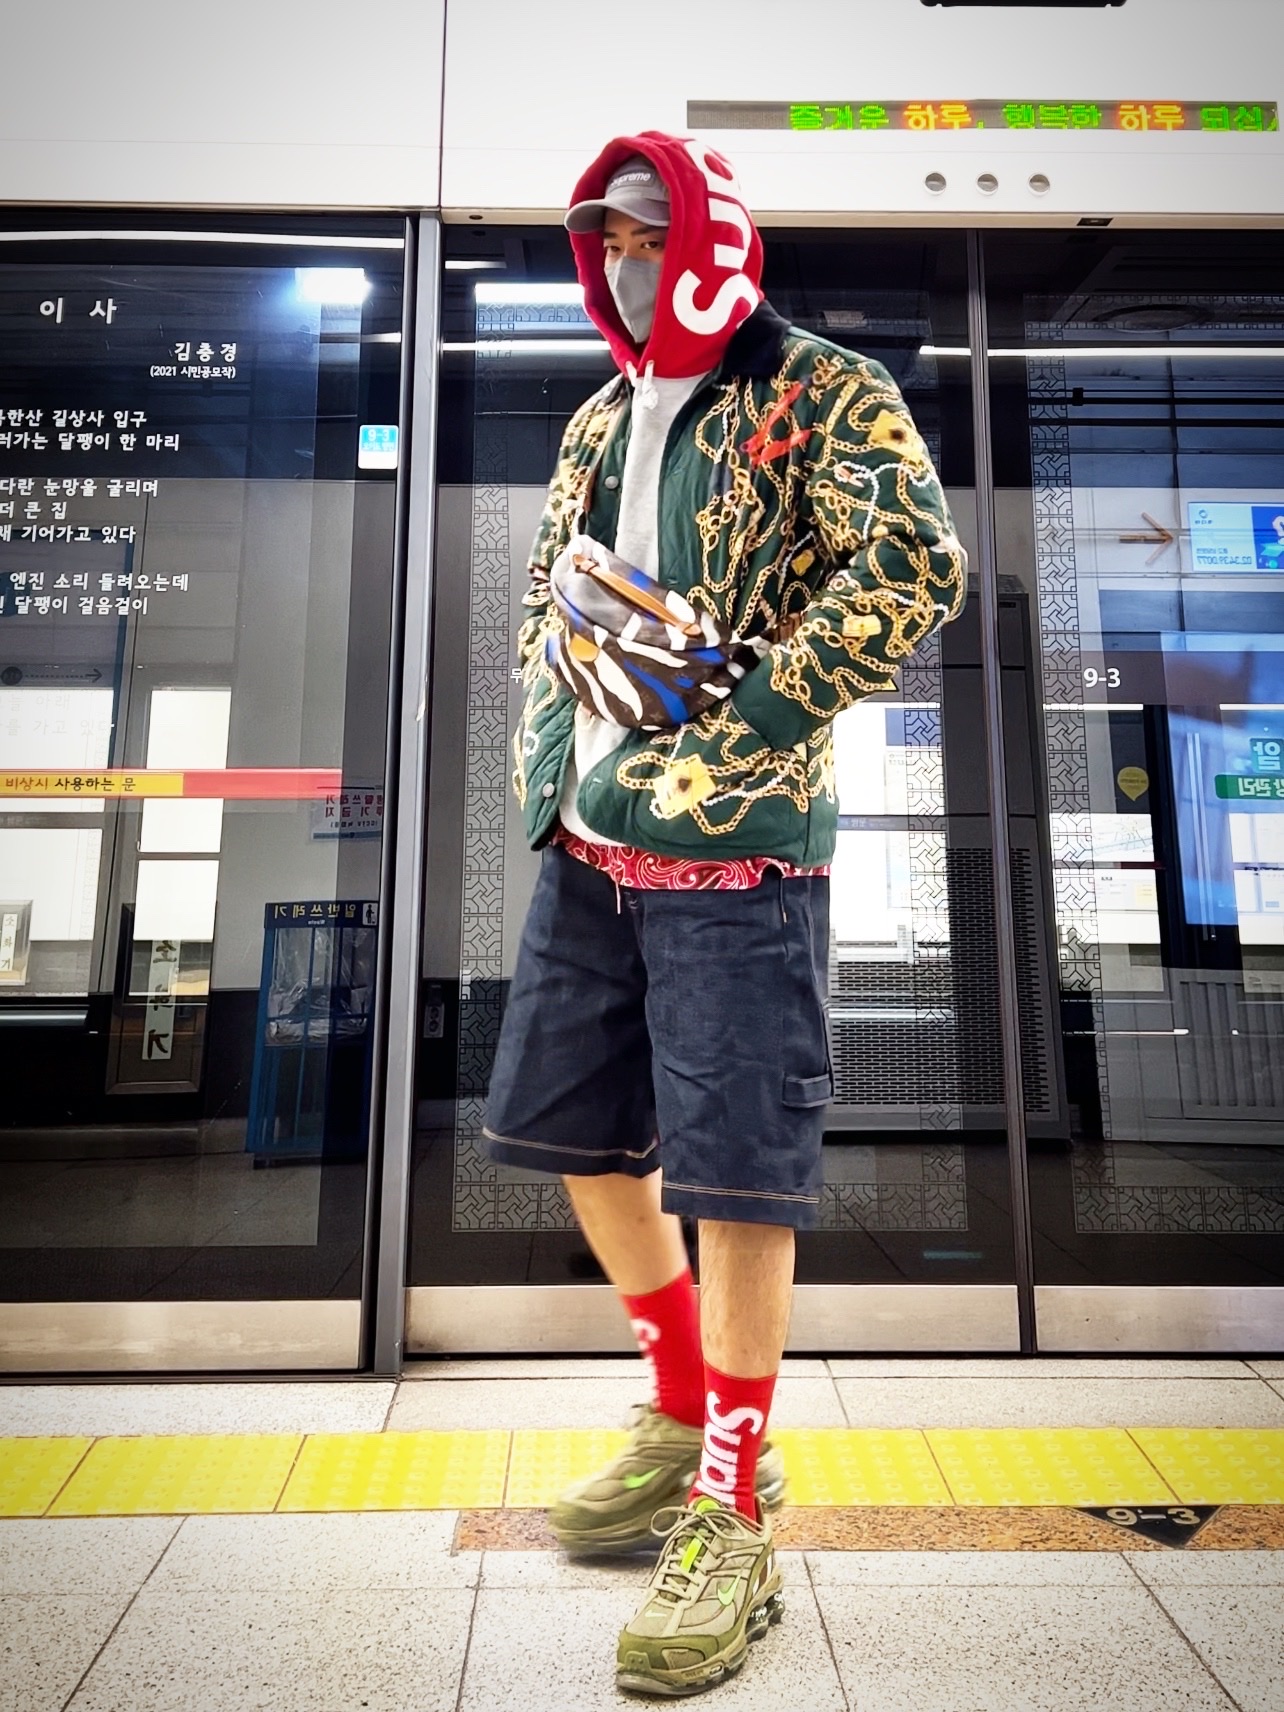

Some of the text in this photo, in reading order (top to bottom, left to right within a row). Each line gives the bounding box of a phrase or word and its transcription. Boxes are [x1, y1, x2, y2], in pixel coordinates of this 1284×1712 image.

[1118, 105, 1184, 131] 하루
[150, 365, 176, 377] (2021
[0, 409, 147, 428] 한산 길상사 입구
[58, 432, 110, 450] 달팽이
[119, 433, 136, 451] 한
[146, 433, 180, 451] 마리
[43, 478, 97, 497] 눈망울
[106, 479, 158, 497] 굴리며
[23, 502, 42, 520] 큰
[51, 501, 67, 519] 집
[21, 525, 91, 543] 기어가고
[101, 525, 136, 543] 있다
[9, 572, 189, 592] 엔진 소리 들려오는데
[14, 596, 68, 615] 달팽이
[78, 597, 148, 615] 걸음걸이
[1083, 668, 1121, 688] 9-3
[5, 776, 136, 792] 비상시 사용하는 문
[1106, 1507, 1200, 1526] 9-3
